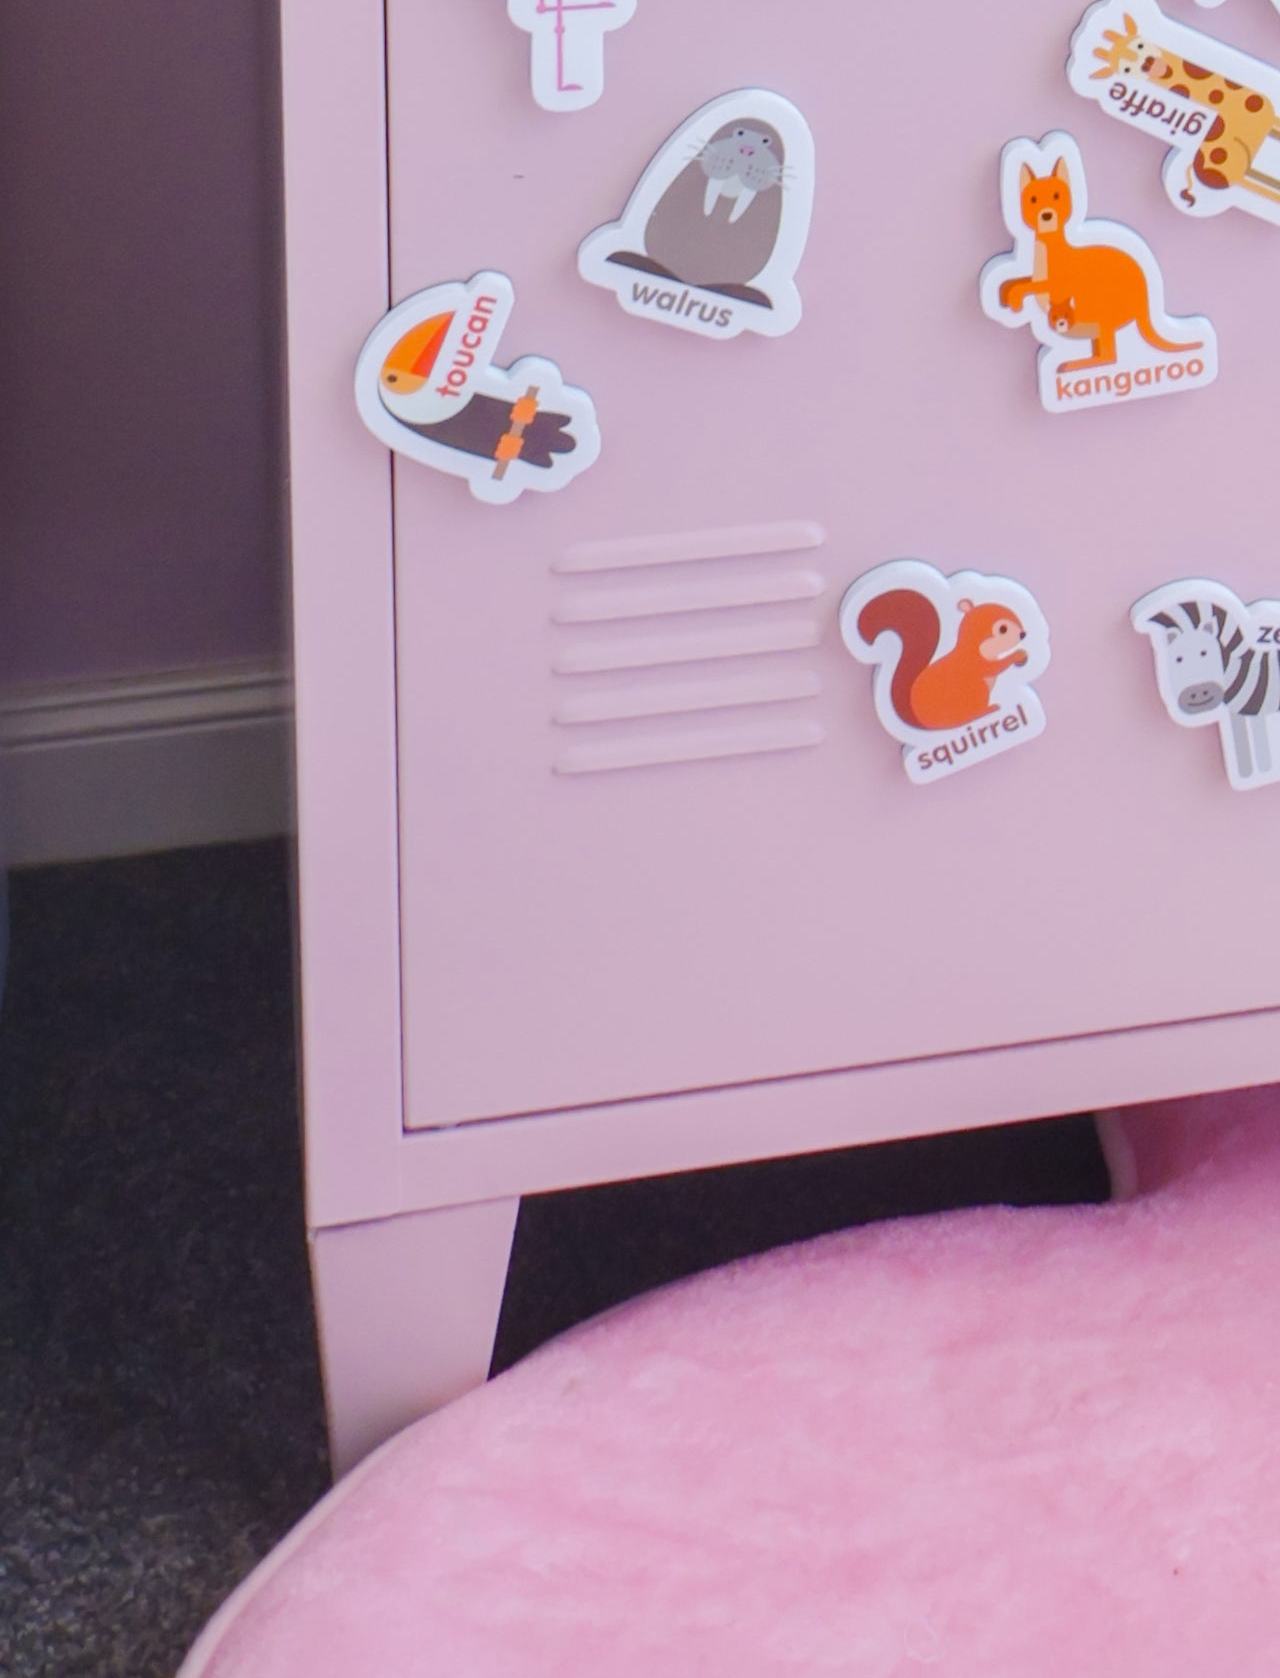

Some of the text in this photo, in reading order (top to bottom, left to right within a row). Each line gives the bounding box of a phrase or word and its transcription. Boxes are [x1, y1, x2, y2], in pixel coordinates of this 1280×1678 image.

[1109, 82, 1207, 136] giraffe
[631, 281, 733, 328] walrus
[436, 296, 497, 398] toucan
[1055, 356, 1205, 401] kangaroo
[916, 705, 1029, 772] squirrel
